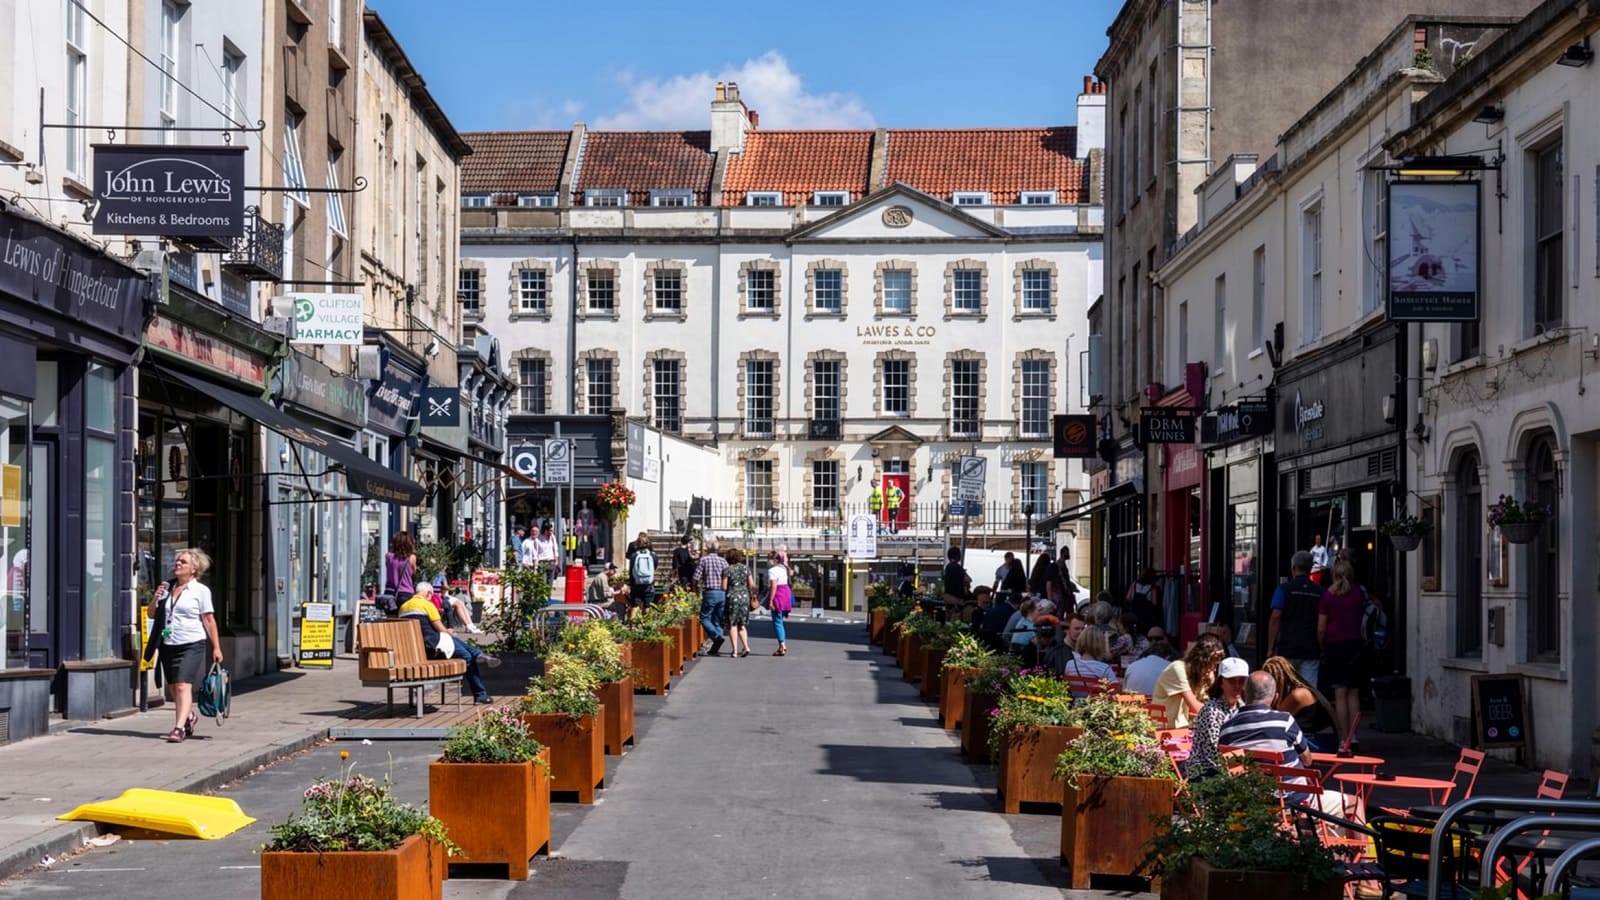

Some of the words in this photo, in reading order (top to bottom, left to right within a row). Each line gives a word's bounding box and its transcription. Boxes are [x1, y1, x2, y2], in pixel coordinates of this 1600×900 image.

[101, 170, 155, 198] John
[164, 171, 231, 194] Lewis
[106, 213, 156, 225] Kitchens
[159, 214, 167, 225] &
[170, 214, 230, 226] Bedrooms
[3, 228, 42, 277] Lewis
[42, 247, 61, 283] of
[55, 252, 122, 310] Hungerford
[318, 299, 361, 309] CLIFTON
[318, 314, 361, 324] VILLAGE
[296, 328, 361, 340] HARMACY
[856, 325, 900, 338] LAWES
[904, 325, 914, 338] &
[917, 325, 936, 338] CO
[1150, 417, 1184, 431] DRM
[1150, 430, 1185, 441] WINES
[514, 452, 538, 475] Q
